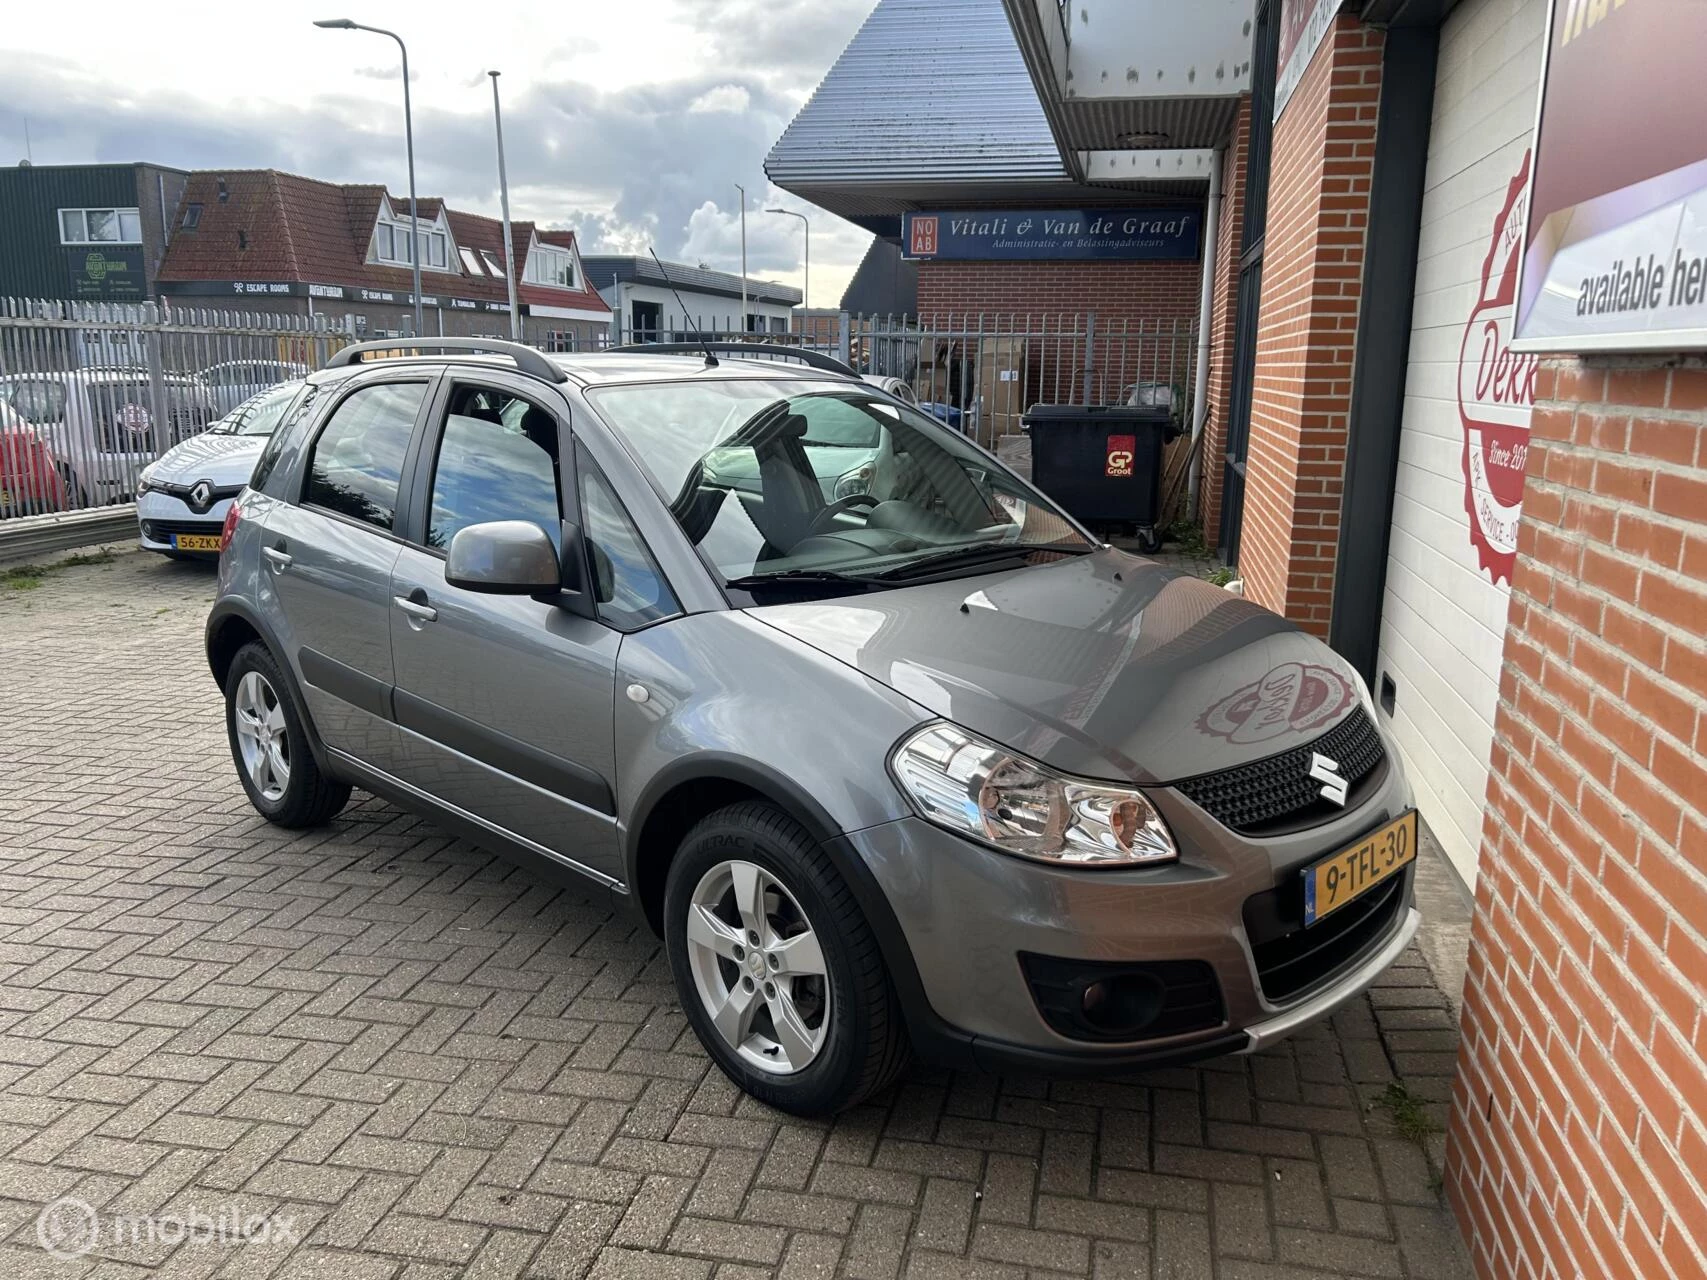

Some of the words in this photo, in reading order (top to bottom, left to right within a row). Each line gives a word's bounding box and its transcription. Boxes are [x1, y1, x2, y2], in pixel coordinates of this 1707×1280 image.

[917, 220, 933, 235] NO
[951, 218, 1007, 236] Vitali
[1016, 218, 1032, 235] &
[1044, 219, 1080, 235] Van
[1090, 217, 1113, 234] de
[1123, 216, 1190, 238] Graaf
[916, 236, 932, 251] AB
[246, 284, 267, 293] ESCAPE
[270, 284, 289, 293] ROOMS
[1577, 254, 1664, 316] available
[1489, 440, 1510, 467] Since
[1481, 498, 1505, 542] SERVICE
[181, 537, 221, 549] 56-ZKX
[1326, 824, 1407, 904] 9-TFL-30
[1305, 902, 1314, 915] NL
